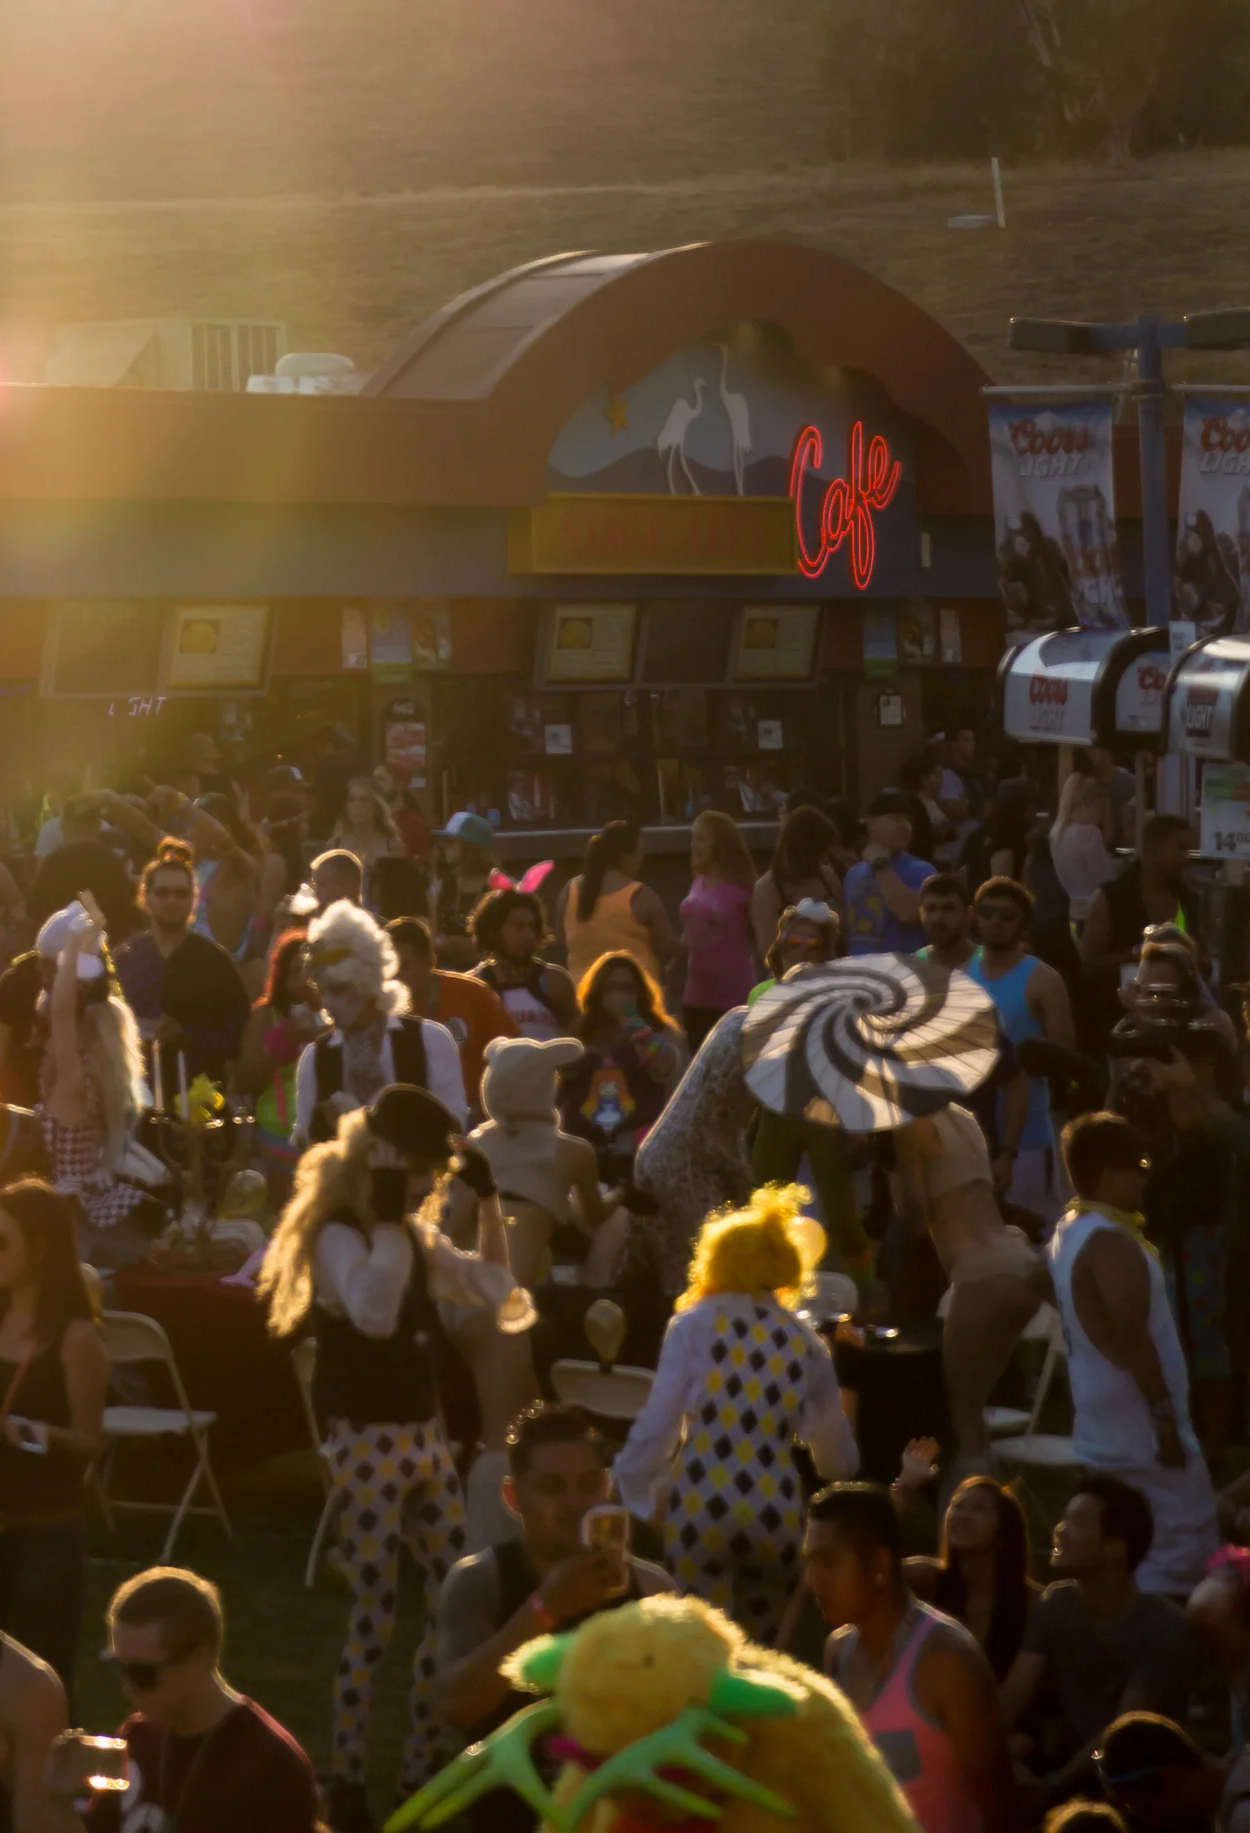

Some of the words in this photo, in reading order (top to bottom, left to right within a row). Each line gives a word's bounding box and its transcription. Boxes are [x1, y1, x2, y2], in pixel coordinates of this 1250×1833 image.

[1007, 418, 1094, 455] Coors
[1018, 452, 1086, 478] LIGHT
[789, 420, 902, 590] Cafe
